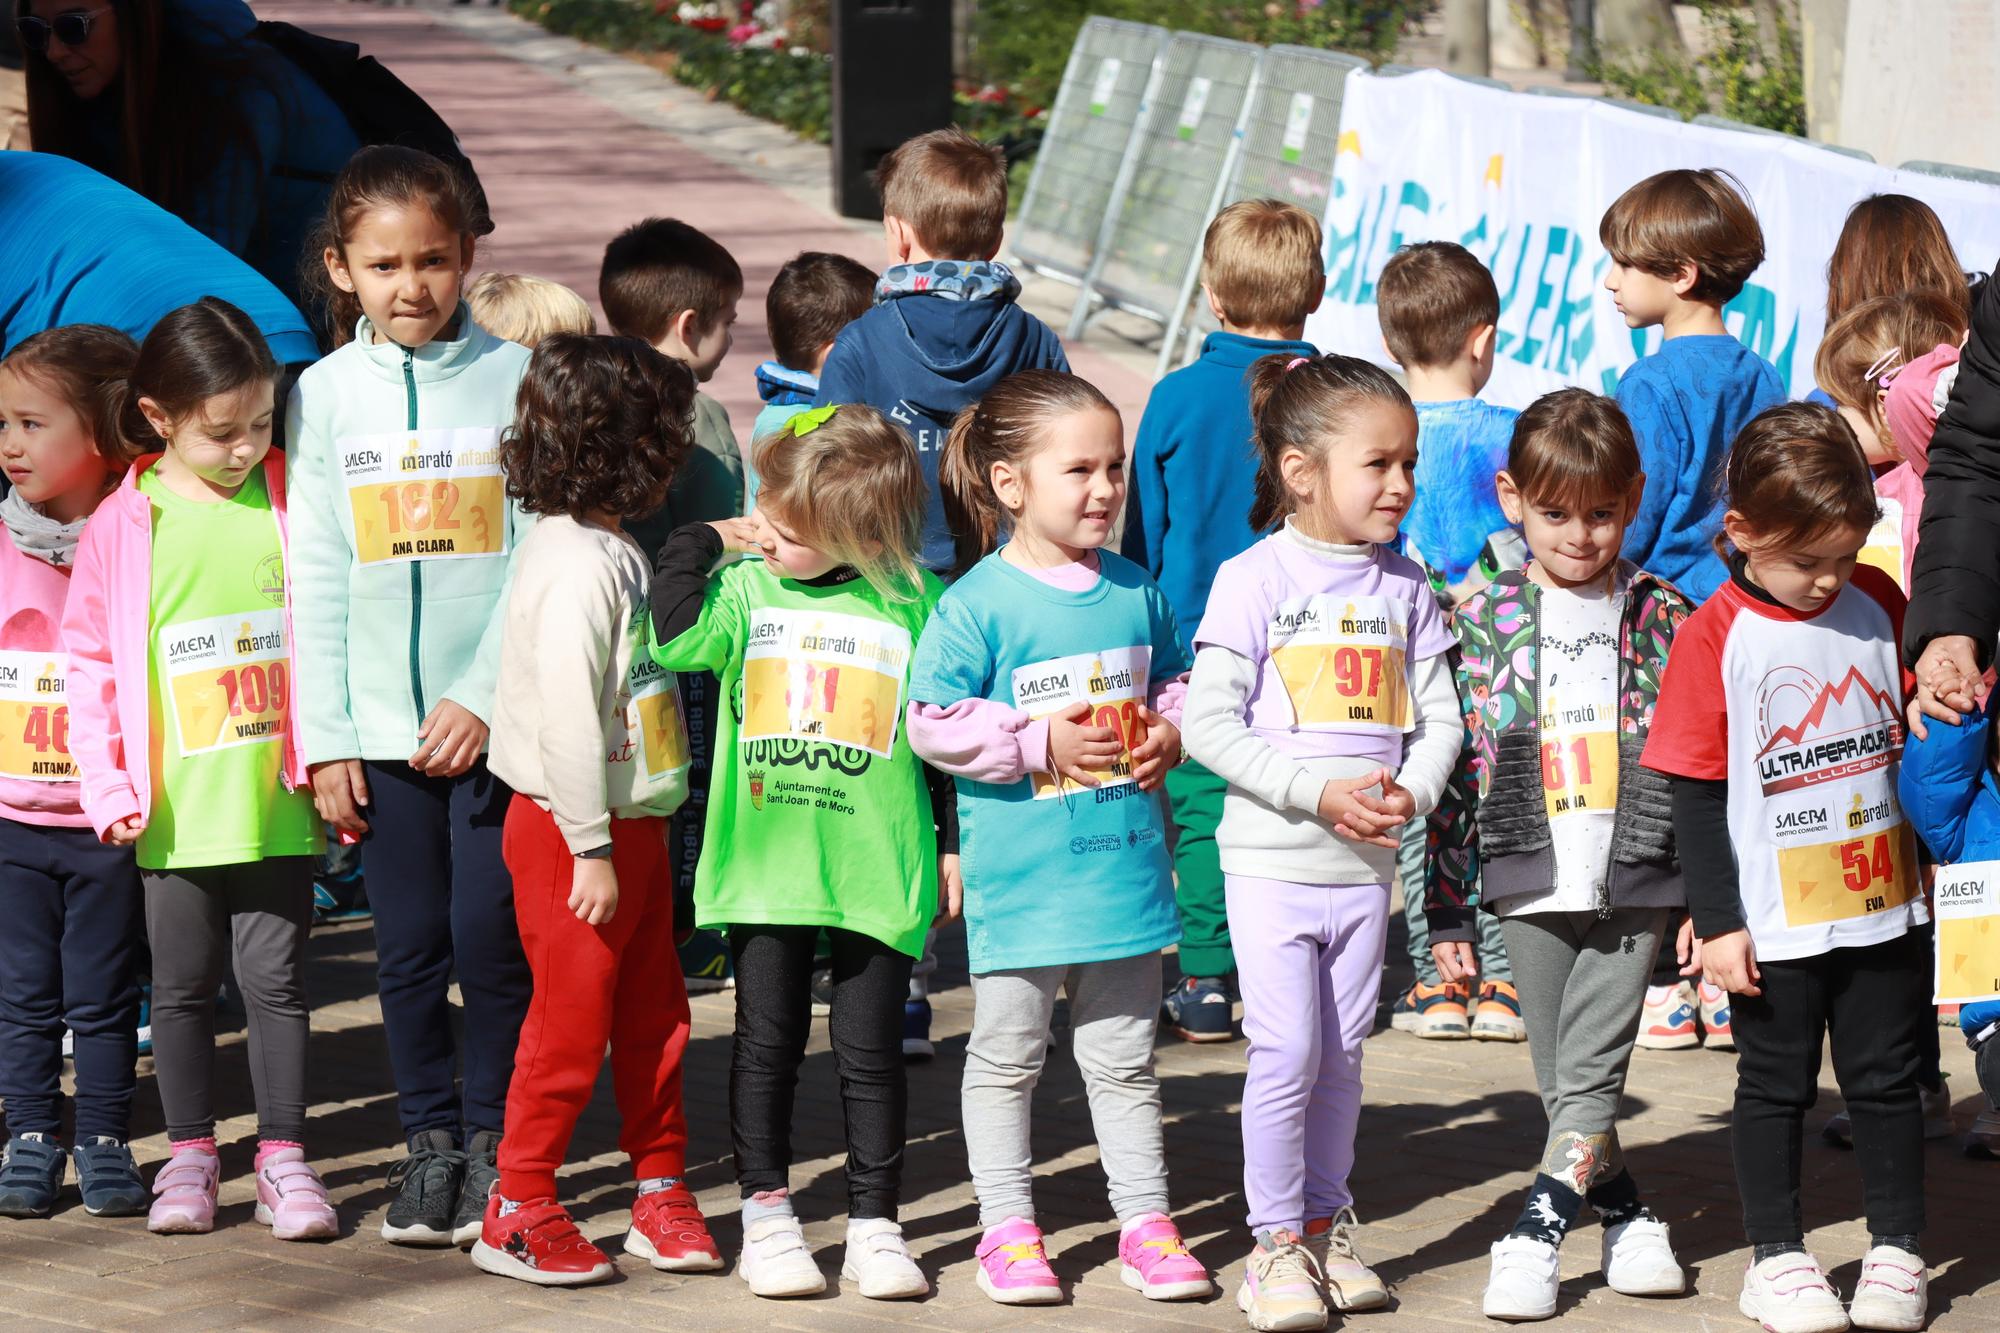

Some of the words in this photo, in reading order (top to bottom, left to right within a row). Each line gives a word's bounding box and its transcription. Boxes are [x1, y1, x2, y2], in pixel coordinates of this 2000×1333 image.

[402, 450, 452, 470] marató
[380, 482, 460, 533] 162
[393, 543, 413, 556] ANA
[417, 539, 455, 553] CLARA
[1341, 616, 1387, 635] marató
[169, 634, 216, 657] SALERA
[237, 630, 281, 653] marató
[802, 633, 855, 655] marató
[1090, 669, 1132, 693] marató
[1334, 647, 1382, 698] 97
[216, 662, 286, 718] 109
[1019, 673, 1069, 697] SALERA
[1348, 706, 1374, 720] LOLA
[689, 706, 707, 769] ABOVE
[32, 761, 70, 775] AITANA
[1111, 762, 1131, 777] MIA
[1541, 736, 1593, 792] 61
[1803, 754, 1890, 784] LLUCENA
[774, 780, 831, 796] Ajuntament
[832, 788, 847, 800] de
[766, 793, 784, 804] Sant
[785, 795, 809, 806] Joan
[815, 796, 827, 809] de
[829, 800, 855, 815] Moró
[1849, 799, 1890, 828] marató
[1775, 808, 1828, 829] SALERA
[1088, 836, 1121, 845] RUNNING
[1776, 829, 1797, 838] CENTRO
[1840, 834, 1894, 892] 54
[1940, 880, 1985, 898] SALERA
[1865, 895, 1886, 913] EVA
